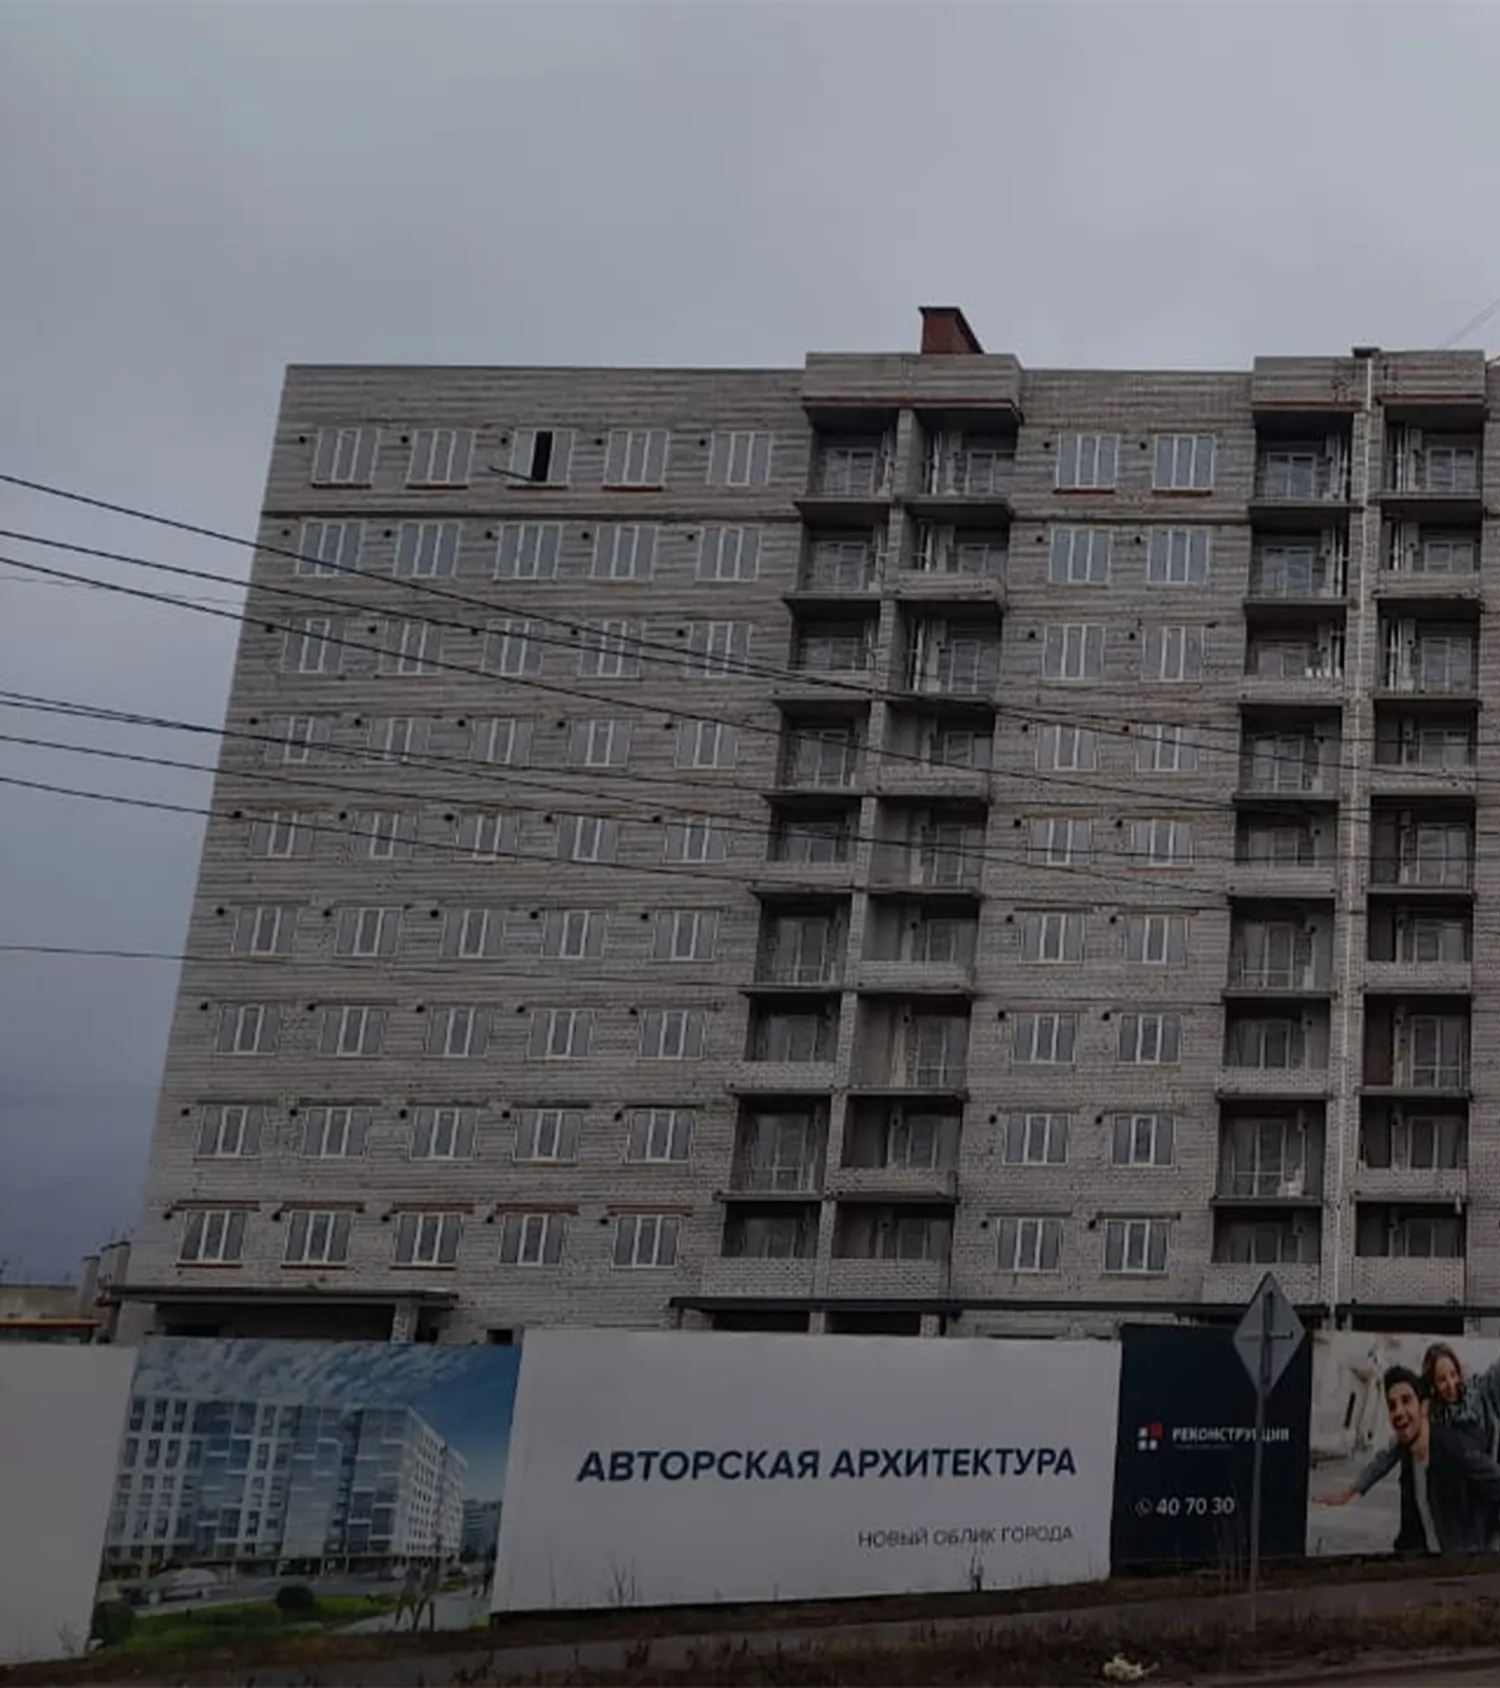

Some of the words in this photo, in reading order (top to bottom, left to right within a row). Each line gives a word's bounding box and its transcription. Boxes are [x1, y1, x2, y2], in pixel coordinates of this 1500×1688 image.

[576, 1450, 819, 1482] АВТОРСКАЯ
[830, 1448, 1077, 1478] АРХИТЕКТУРА
[1156, 1498, 1180, 1515] 40
[1185, 1497, 1207, 1515] 70
[1212, 1497, 1235, 1514] 30
[858, 1526, 928, 1548] НОВЫЙ
[934, 1528, 995, 1546] ОБЛИК
[1001, 1525, 1074, 1544] ГОРОДА
